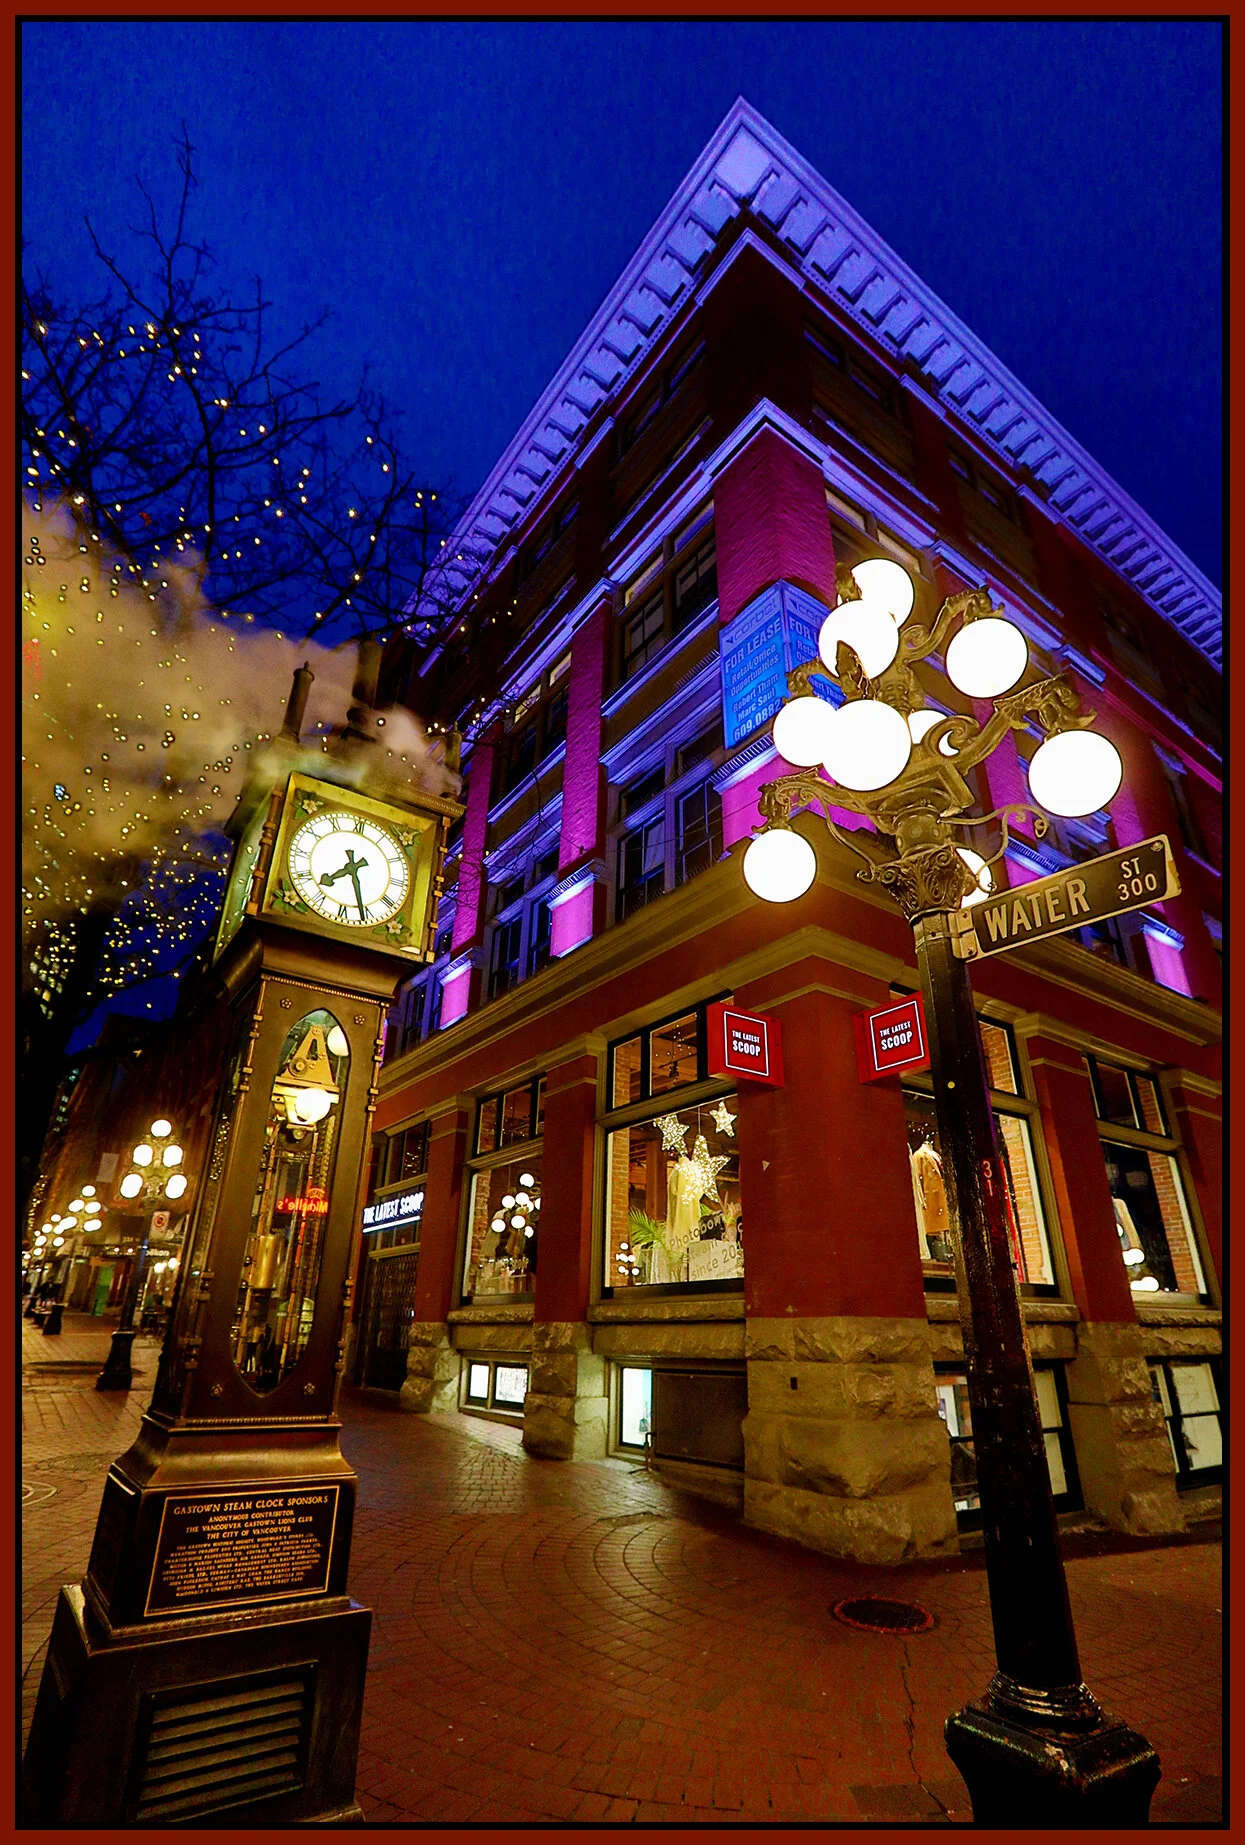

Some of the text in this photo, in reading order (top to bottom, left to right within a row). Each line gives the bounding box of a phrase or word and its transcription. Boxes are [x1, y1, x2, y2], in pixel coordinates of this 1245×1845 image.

[789, 616, 811, 640] FOR
[725, 648, 745, 673] FOR
[747, 617, 781, 654] LEASE
[731, 654, 779, 696] Opportunities
[733, 673, 779, 713] Robert Tham
[738, 687, 775, 722] Marc Saul
[734, 698, 781, 741] 609.0882
[1120, 857, 1141, 879] ST
[1117, 873, 1158, 901] 300
[984, 878, 1091, 942] WATER
[732, 1030, 760, 1044] THE LATEST
[880, 1021, 911, 1037] THE LATEST
[733, 1040, 761, 1057] SCOOP
[881, 1031, 913, 1051] SCOOP
[363, 1192, 424, 1225] THE LATEST SCOOP
[690, 1258, 719, 1281] since
[174, 1495, 328, 1515] GASTOWN STEAM CLOCK SPONSORS
[208, 1509, 295, 1523] ANONYMOUS CONTRIBUTOR
[186, 1526, 199, 1534] THE
[202, 1522, 242, 1532] VANCOUVER
[244, 1519, 276, 1528] GASTOWN
[278, 1517, 296, 1525] LIONS
[206, 1532, 220, 1540] THE
[222, 1530, 239, 1539] CITY
[252, 1525, 292, 1535] VANCOUVER
